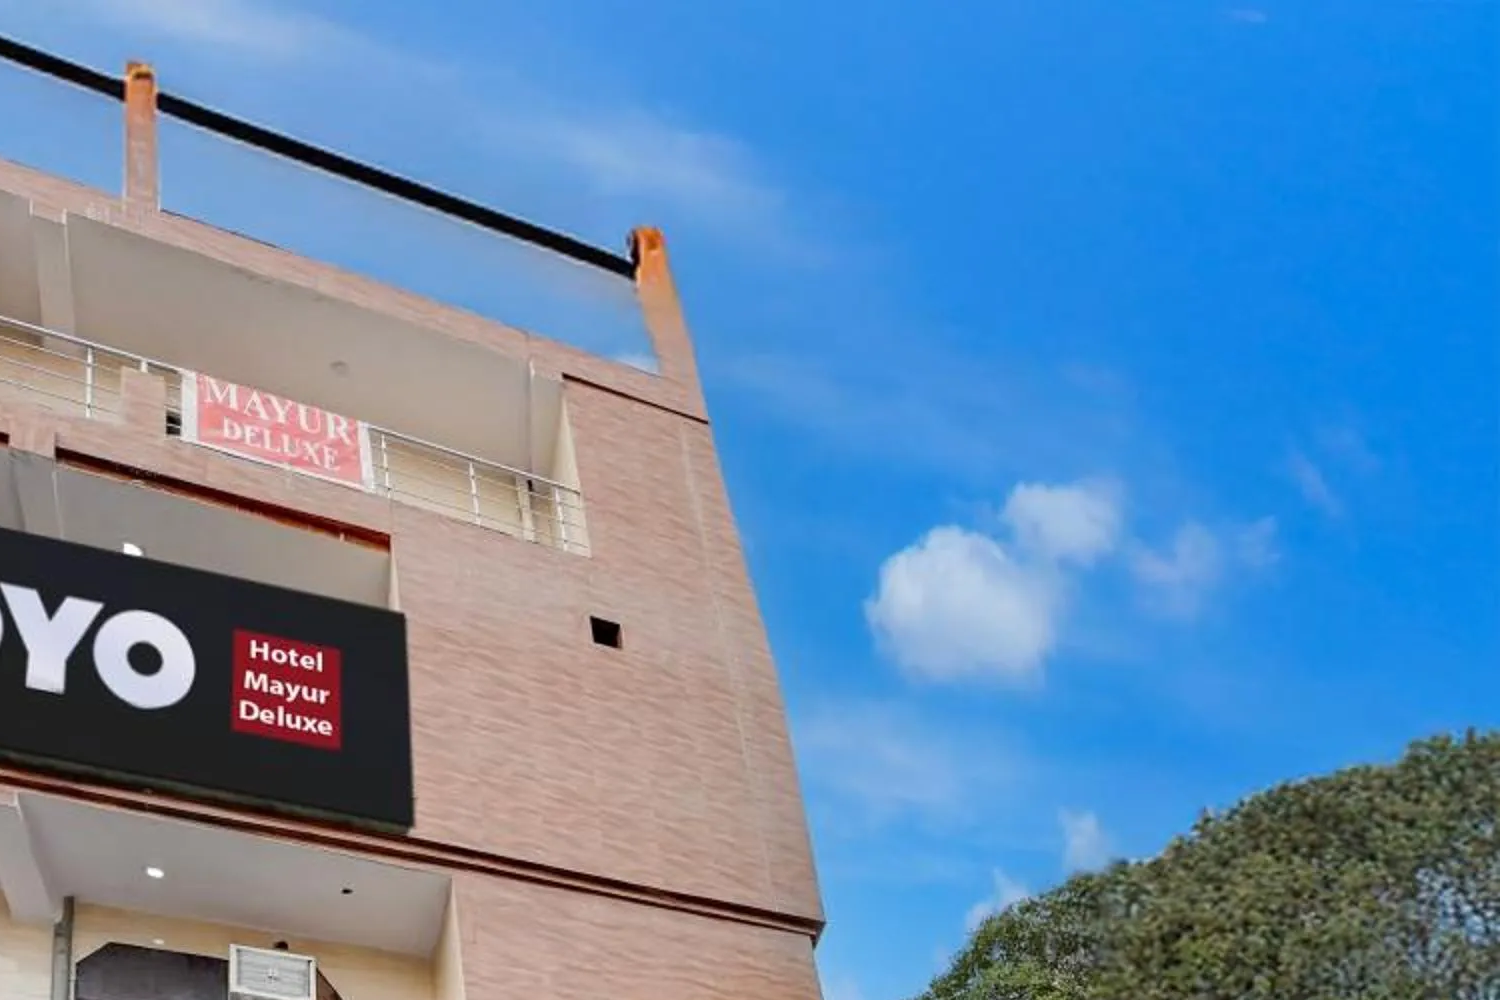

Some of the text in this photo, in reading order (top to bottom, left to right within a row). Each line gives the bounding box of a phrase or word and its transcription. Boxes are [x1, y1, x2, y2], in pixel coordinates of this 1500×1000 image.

[202, 375, 352, 446] MAYUR
[222, 416, 342, 471] DELUXE
[249, 639, 323, 672] Hotel
[243, 669, 330, 704] Mayur
[239, 699, 333, 736] Deluxe
